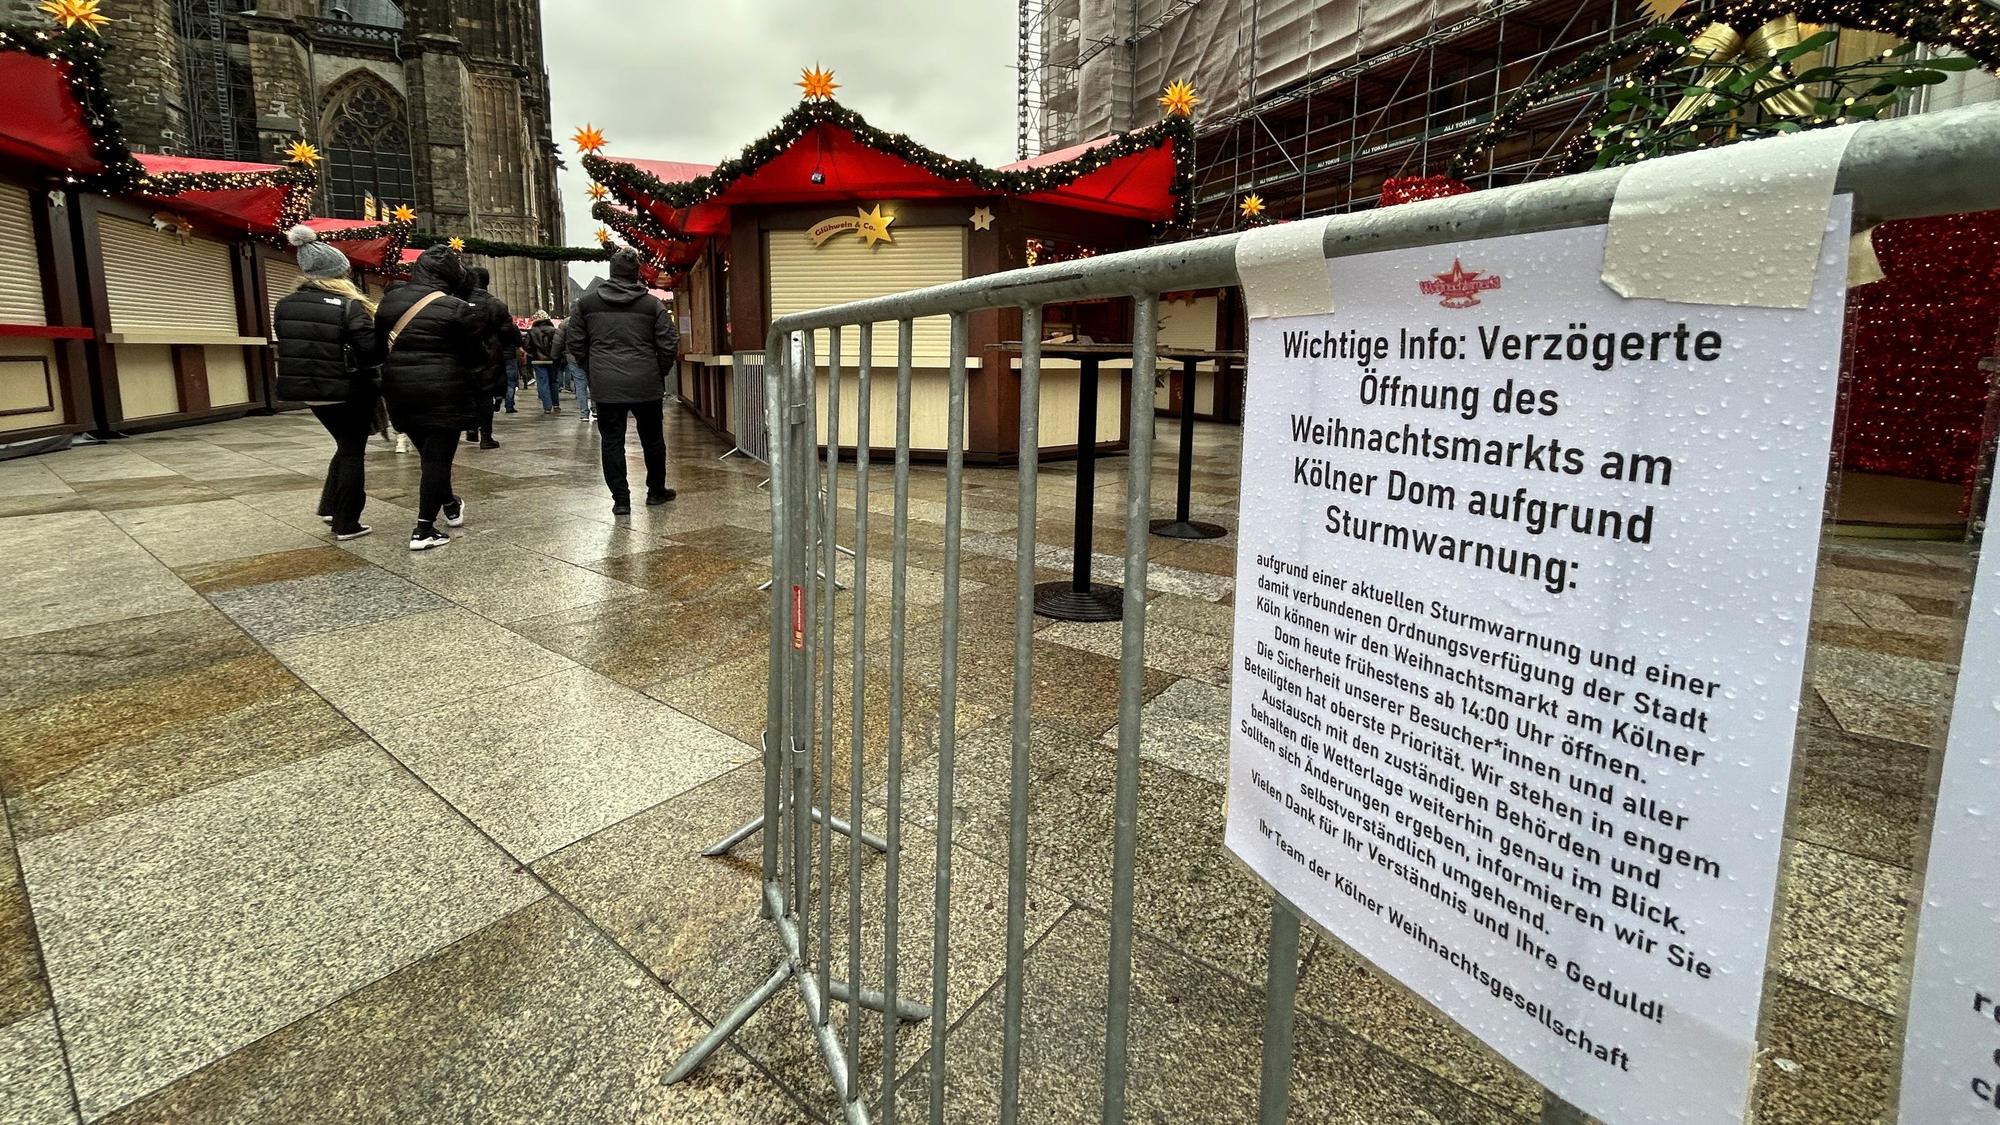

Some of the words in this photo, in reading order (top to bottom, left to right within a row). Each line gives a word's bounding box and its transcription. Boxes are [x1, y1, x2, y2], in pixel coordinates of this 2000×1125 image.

[1371, 143, 1388, 153] TOKUS
[1455, 118, 1477, 129] TOKUS
[815, 222, 853, 236] Glühwein
[864, 222, 876, 231] Co.
[1283, 329, 1388, 367] Wichtige
[1400, 327, 1466, 360] Info:
[1478, 323, 1722, 372] Verzögerte
[1360, 368, 1479, 420] Öffnung
[1493, 378, 1559, 416] des
[1291, 414, 1584, 475] Weihnachtsmarkts
[1600, 452, 1672, 486] am
[1294, 457, 1378, 496] Kölner
[1388, 470, 1455, 511] Dom
[1468, 488, 1654, 544] aufgrund
[1257, 555, 1308, 580] aufgrund
[1313, 569, 1347, 591] einer
[1352, 581, 1424, 614] aktuellen
[1430, 601, 1581, 665] Sturmwarnung
[1590, 650, 1636, 677] und
[1646, 664, 1721, 698] einer
[1325, 505, 1578, 594] Sturmwarnung:
[1257, 596, 1280, 618] Köln
[1284, 606, 1329, 636] können
[1334, 628, 1357, 645] wir
[1362, 635, 1388, 657] den
[1394, 644, 1558, 719] Weihnachtsmarkt
[1567, 710, 1602, 735] am
[1612, 718, 1705, 766] Kölner
[1258, 575, 1289, 598] damit
[1293, 589, 1381, 628] verbundenen
[1387, 616, 1574, 696] Ordnungsverfügung
[1583, 678, 1625, 706] der
[1633, 692, 1708, 734] Stadt
[1275, 625, 1300, 649] Dom
[1304, 637, 1340, 665] heute
[1346, 654, 1429, 699] frühestens
[1435, 690, 1454, 709] ab
[1462, 697, 1509, 730] 14:00
[1516, 717, 1554, 747] Uhr
[1562, 734, 1646, 784] öffnen.
[1245, 656, 1301, 697] Beteiligten
[1306, 686, 1326, 709] hat
[1331, 701, 1385, 735] oberste
[1391, 723, 1464, 771] Priorität.
[1472, 758, 1503, 787] Wir
[1509, 781, 1582, 825] stehen
[1592, 811, 1613, 839] in
[1624, 830, 1720, 879] engem
[1257, 641, 1273, 660] Die
[1277, 650, 1340, 691] Sicherheit
[1345, 682, 1405, 716] unserer
[1569, 774, 1613, 805] und
[1623, 796, 1689, 831] aller
[1262, 689, 1321, 731] Austausch
[1326, 724, 1348, 744] mit
[1353, 735, 1379, 759] den
[1384, 751, 1488, 811] zuständigen
[1496, 799, 1600, 866] Behörden
[1611, 857, 1660, 889] und
[1242, 720, 1275, 752] Sollten
[1279, 746, 1301, 768] sich
[1305, 755, 1389, 817] Änderungen
[1396, 811, 1469, 862] ergeben,
[1477, 853, 1604, 933] informieren
[1614, 923, 1658, 954] wir
[1667, 944, 1712, 979] Sie
[1251, 703, 1296, 742] behalten
[1301, 734, 1319, 754] die
[1323, 743, 1403, 796] Wetterlage
[1409, 790, 1493, 843] weiterhin
[1500, 836, 1563, 880] genau
[1572, 867, 1602, 898] im
[1612, 884, 1685, 935] Blick.
[1252, 769, 1282, 803] Vielen
[1286, 793, 1315, 825] Dank
[1319, 815, 1339, 837] für
[1343, 829, 1363, 852] Ihr
[1368, 842, 1467, 916] Verständnis
[1474, 908, 1509, 940] und
[1516, 928, 1557, 969] Ihre
[1566, 961, 1664, 1024] Geduld!
[1300, 784, 1436, 869] selbstverständlich
[1443, 862, 1549, 935] umgehend.
[1260, 818, 1273, 839] Ihr
[1275, 831, 1304, 865] Team
[1309, 859, 1331, 881] der
[1335, 873, 1384, 915] Kölner
[1389, 906, 1629, 1070] Weihnachtsgesellschaft
